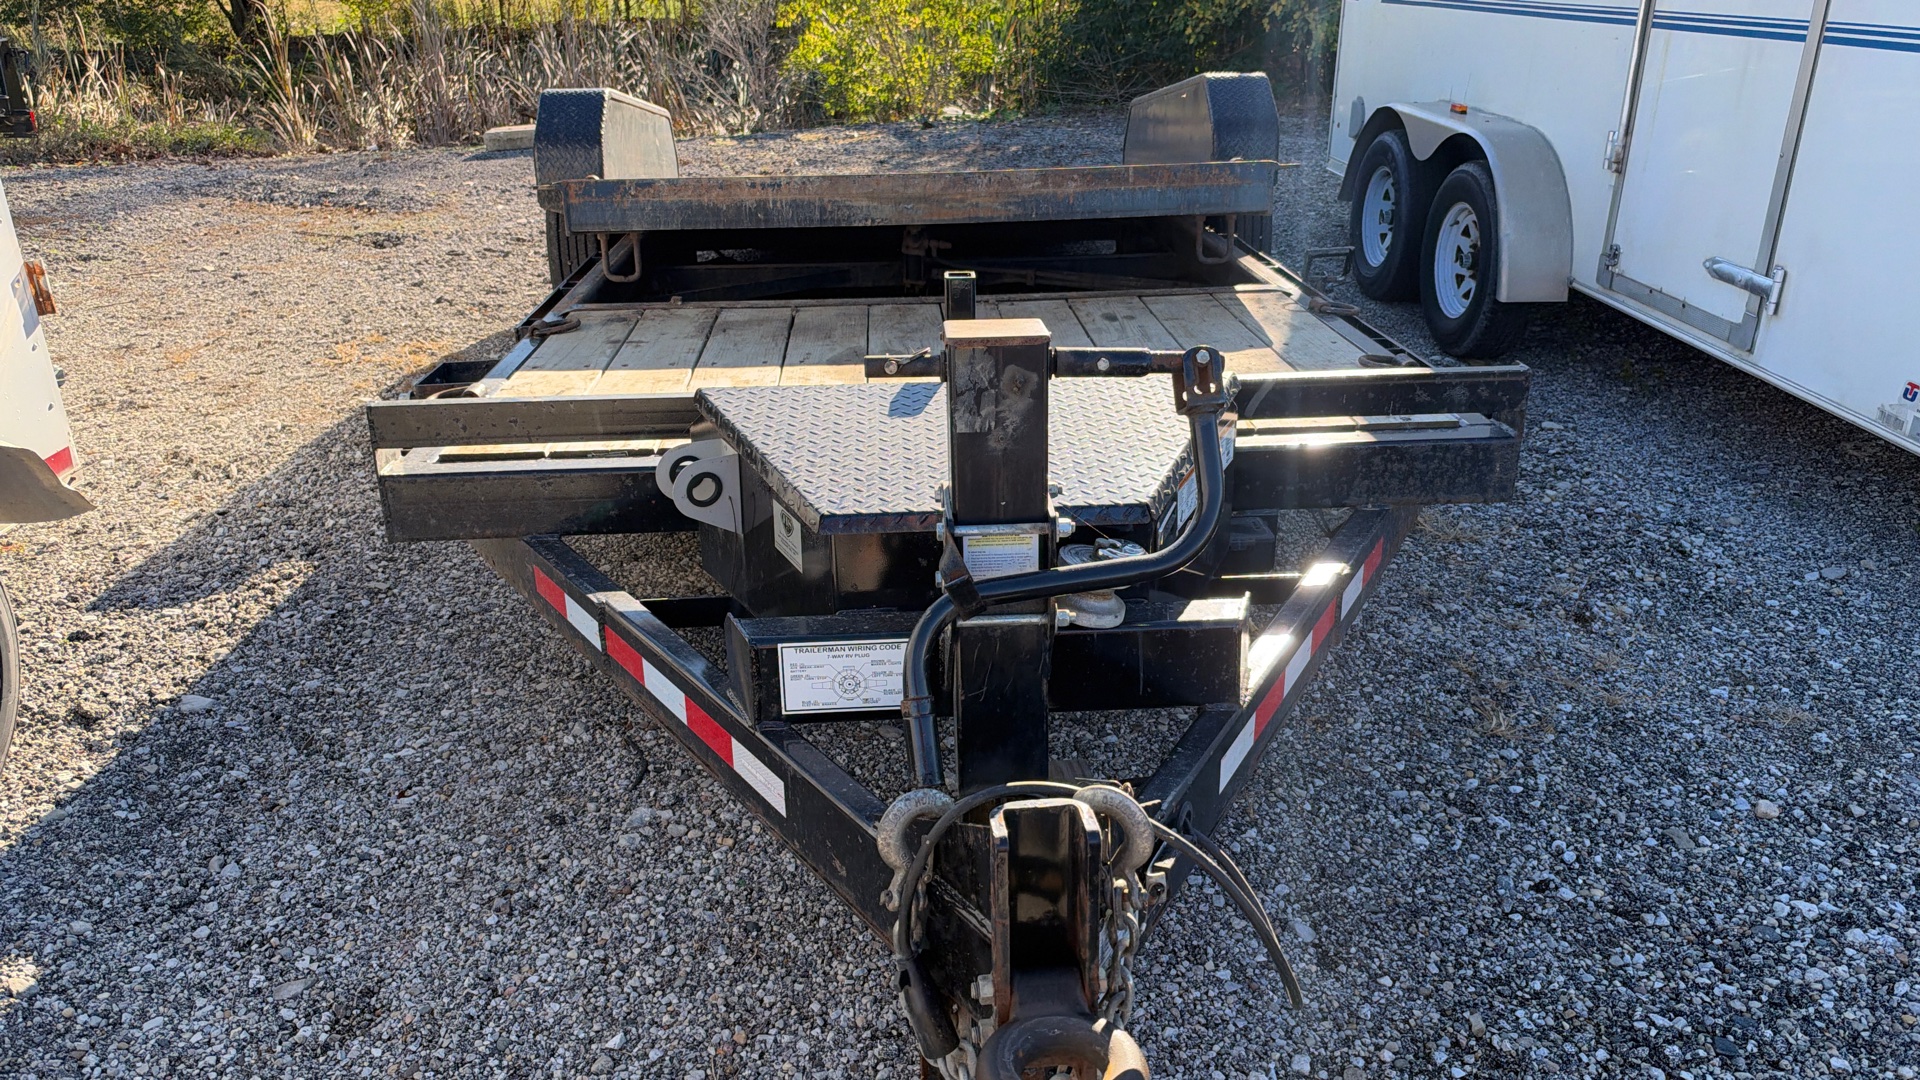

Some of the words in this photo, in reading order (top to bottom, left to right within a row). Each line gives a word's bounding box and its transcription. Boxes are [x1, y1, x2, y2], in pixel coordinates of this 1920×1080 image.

[794, 646, 846, 654] TRAILERMAN
[848, 644, 877, 652] WIRING
[879, 643, 901, 651] CODE
